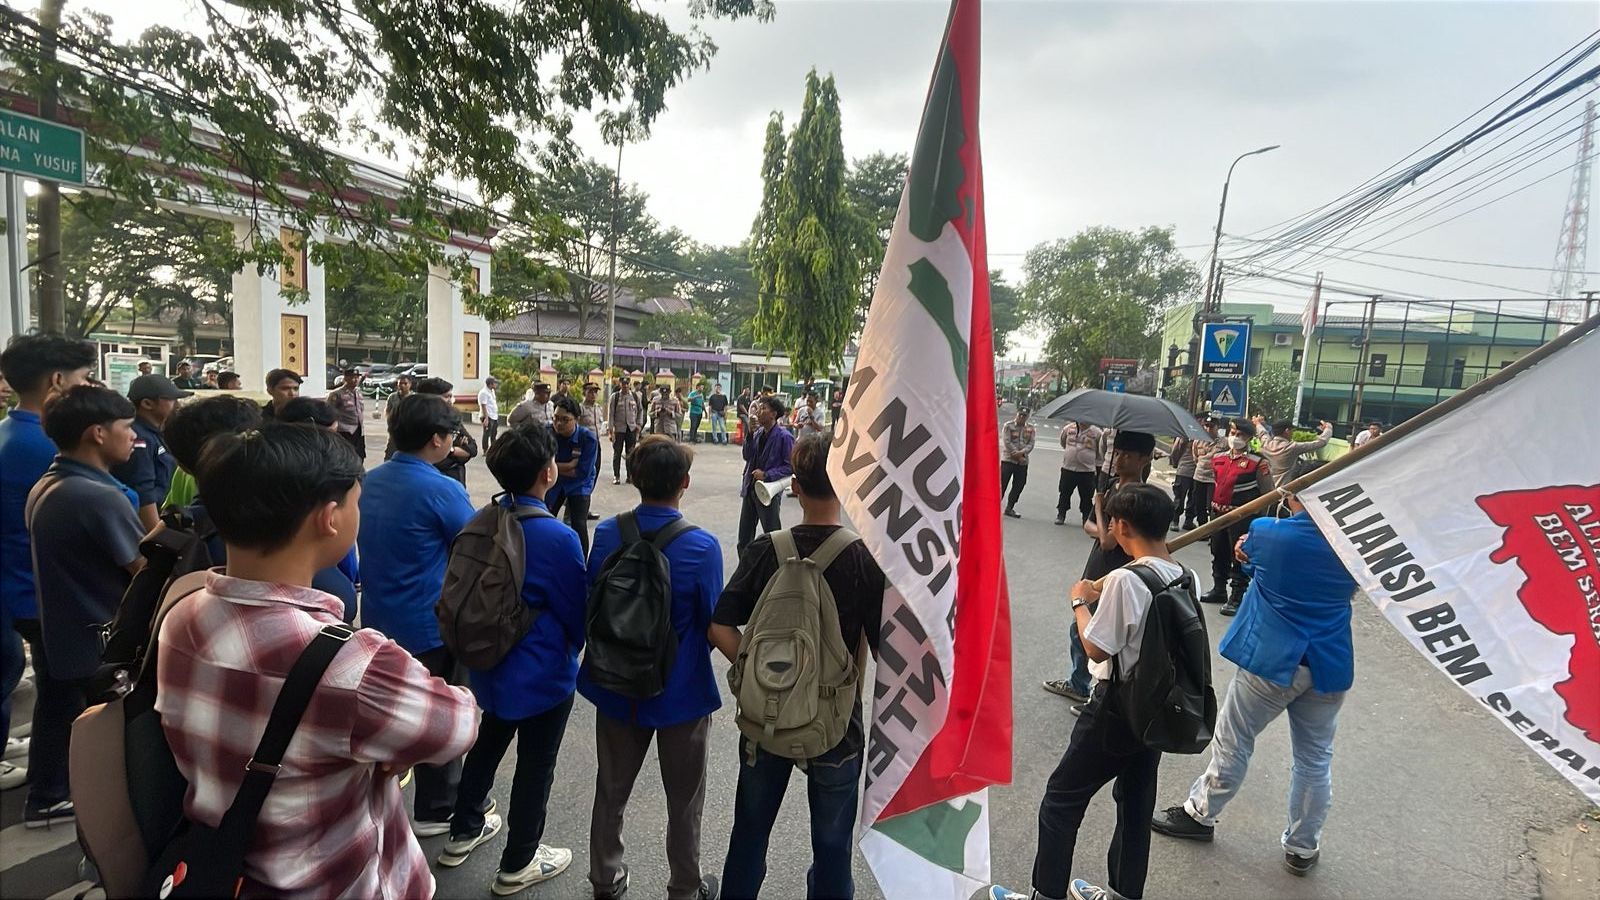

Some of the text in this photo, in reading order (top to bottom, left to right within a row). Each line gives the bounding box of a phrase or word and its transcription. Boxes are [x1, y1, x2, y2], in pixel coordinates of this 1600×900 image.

[33, 152, 78, 174] YUSUF
[1534, 512, 1588, 571] BEM
[1317, 482, 1437, 603] ALIANSI
[1406, 601, 1494, 687] BEM
